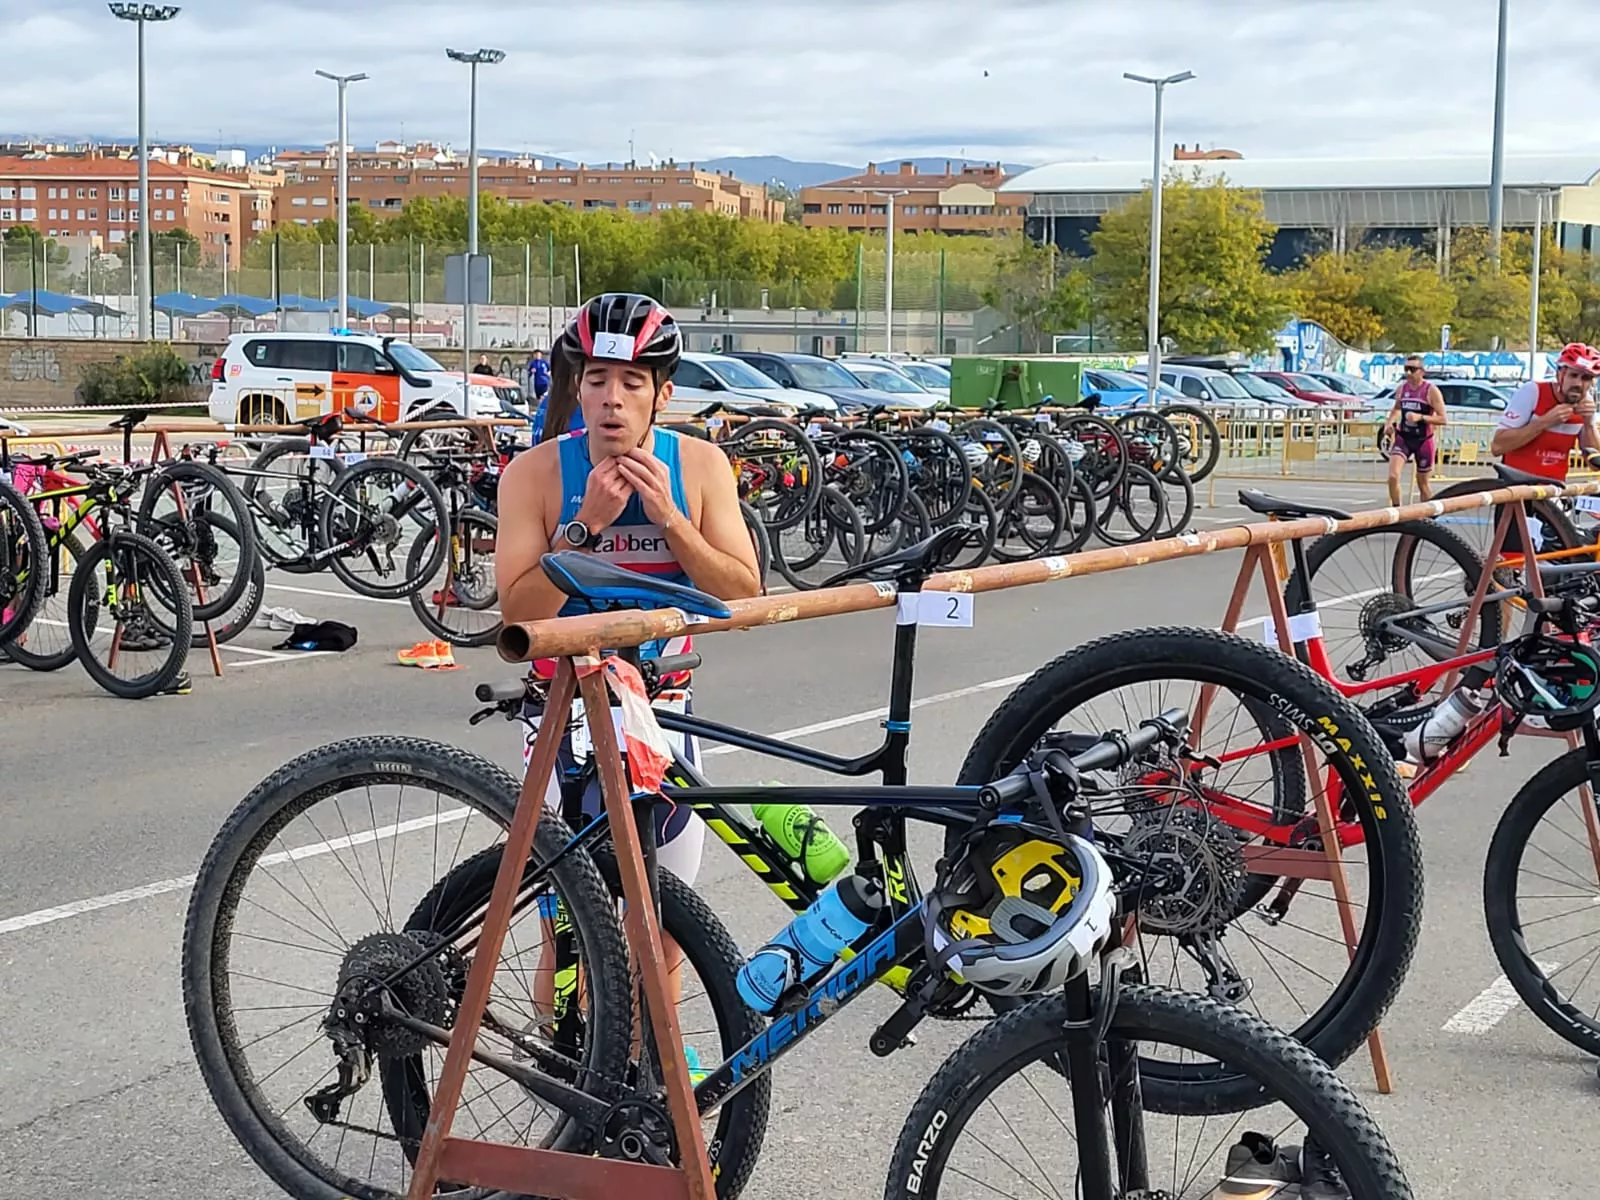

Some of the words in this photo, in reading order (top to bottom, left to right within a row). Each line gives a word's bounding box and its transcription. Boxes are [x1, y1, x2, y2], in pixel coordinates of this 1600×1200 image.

[607, 340, 617, 355] 2
[946, 596, 959, 620] 2
[1267, 692, 1315, 731] SWISS
[1310, 731, 1339, 756] DT
[1316, 715, 1388, 820] MAXXIS
[887, 857, 909, 905] RC
[906, 1109, 949, 1195] BARZO
